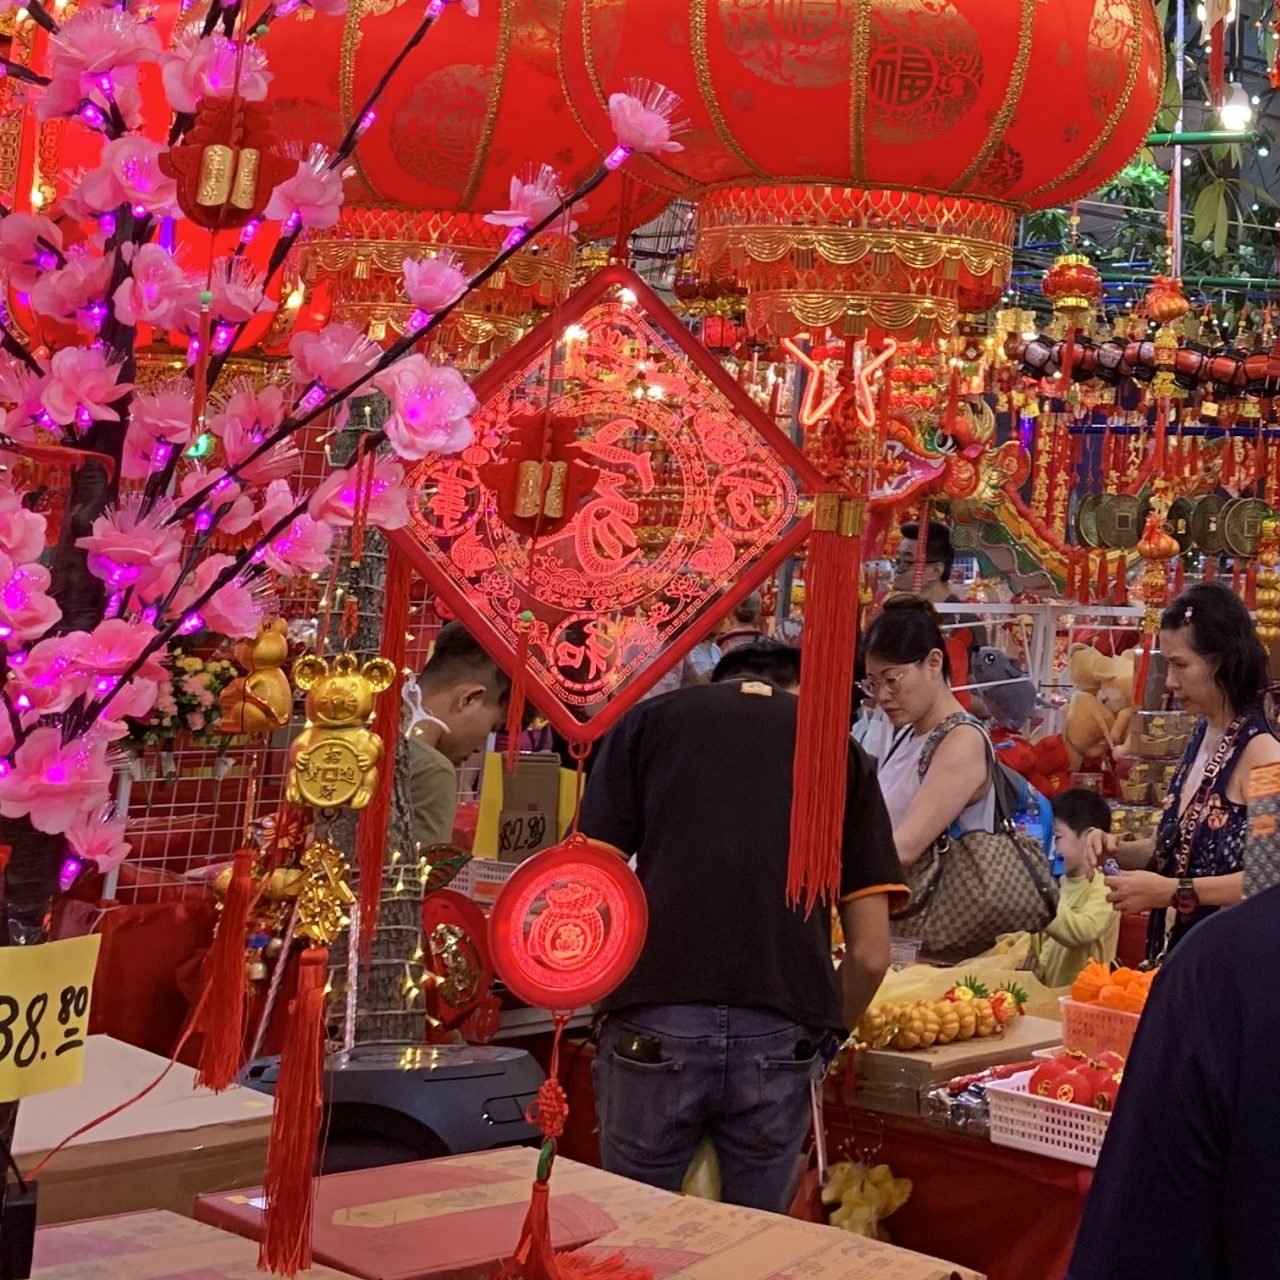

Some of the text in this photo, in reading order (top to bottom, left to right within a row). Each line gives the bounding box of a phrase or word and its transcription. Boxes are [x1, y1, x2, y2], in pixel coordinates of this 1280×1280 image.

[870, 46, 934, 107] 福
[1176, 803, 1203, 874] YOU LOVE
